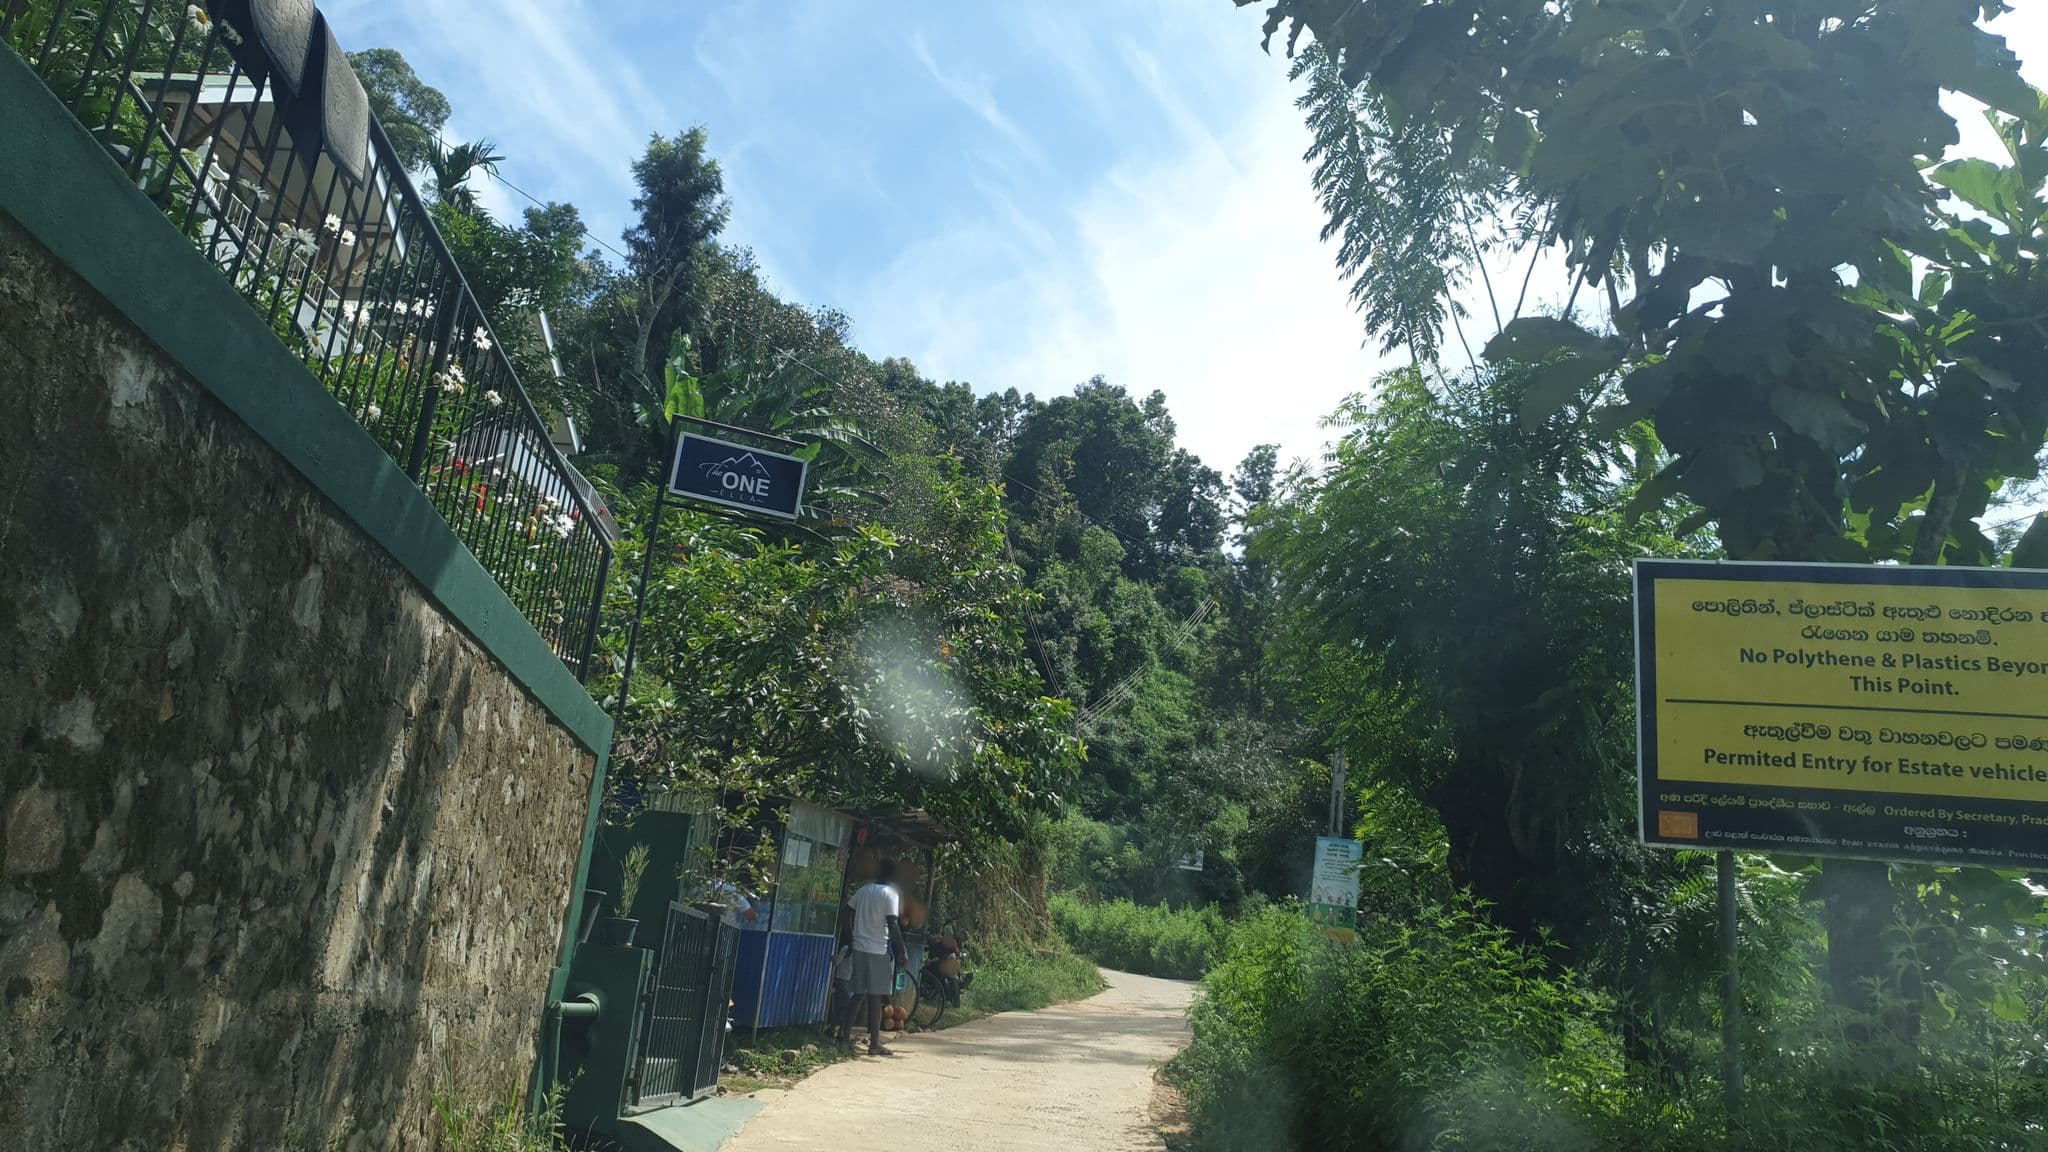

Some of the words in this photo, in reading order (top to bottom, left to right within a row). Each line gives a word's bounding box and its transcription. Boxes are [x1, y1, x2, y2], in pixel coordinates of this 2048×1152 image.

[722, 471, 771, 497] ONE
[720, 488, 756, 502] ELLA
[1876, 627, 1915, 642] යාම
[1740, 648, 1768, 663] No
[1773, 648, 1876, 669] Polythene
[1881, 653, 1897, 668] &
[1902, 653, 1982, 671] Plastics
[1849, 676, 1892, 692] This
[1898, 678, 1960, 695] Point.
[1704, 748, 1797, 769] Permited
[1802, 753, 1857, 775] Entry
[1862, 755, 1892, 773] for
[1898, 758, 1964, 777] Estate
[1884, 805, 1935, 818] Ordered
[1938, 808, 1954, 821] By
[1956, 810, 2019, 826] Secretary,
